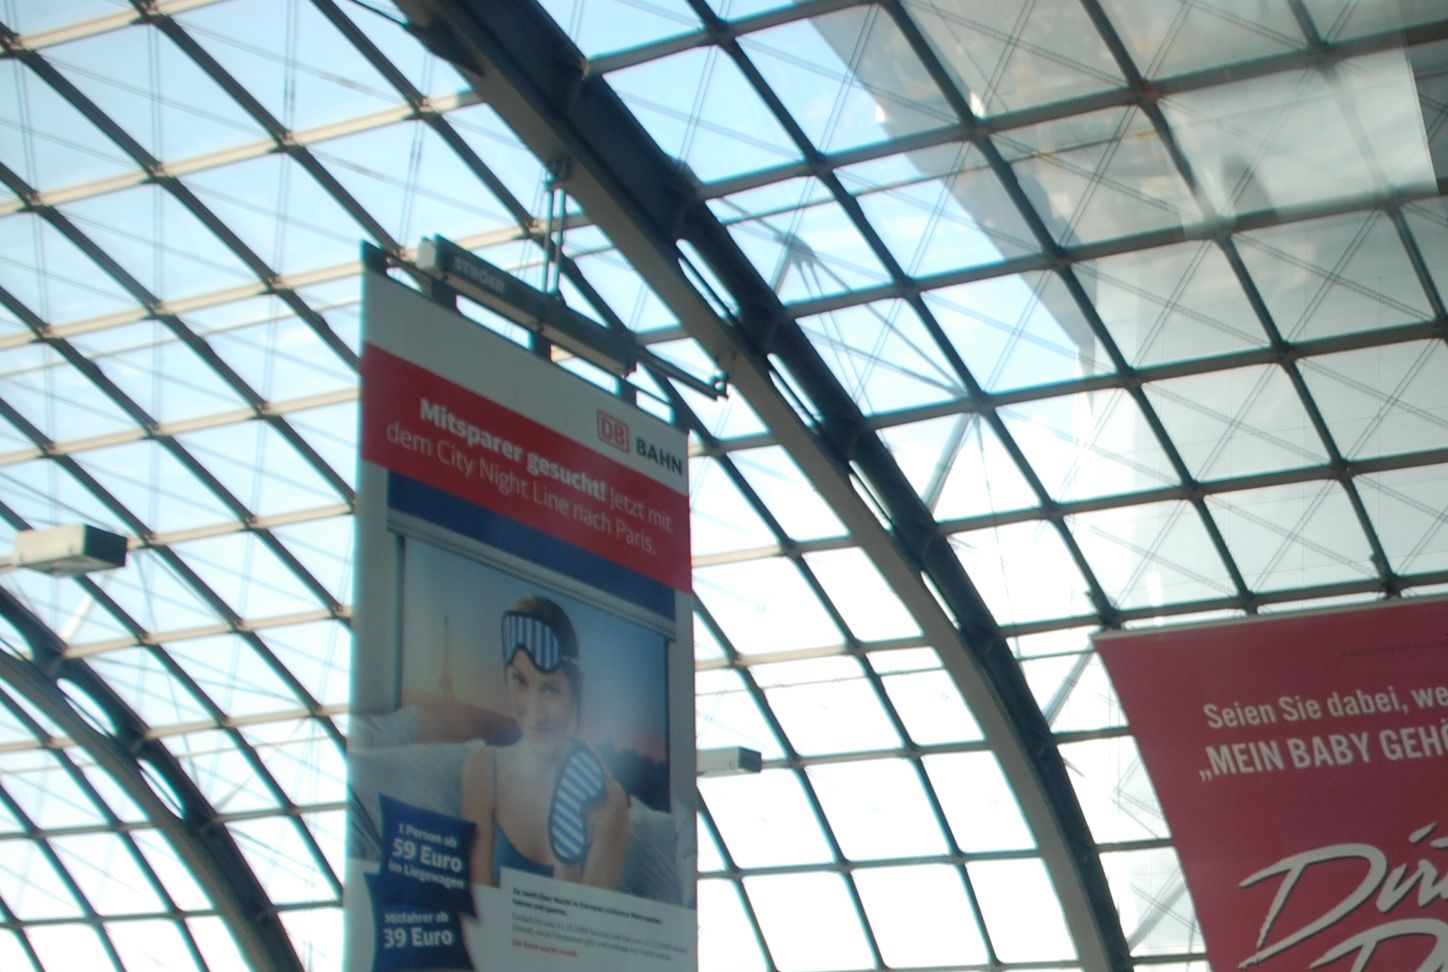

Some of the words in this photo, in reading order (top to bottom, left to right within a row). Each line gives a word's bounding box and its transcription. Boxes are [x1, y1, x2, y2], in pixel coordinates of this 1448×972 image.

[598, 411, 628, 453] DB
[636, 438, 683, 476] BAHN
[420, 398, 523, 463] Mitsparer
[527, 450, 607, 501] gesucht!
[609, 487, 645, 519] Jetzt
[648, 508, 672, 534] mit
[386, 421, 432, 457] dem
[437, 440, 474, 476] City
[480, 459, 528, 497] Night
[533, 487, 569, 516] Line
[573, 505, 611, 534] nach
[616, 524, 656, 554] Paris.
[1203, 702, 1276, 730] Seien
[1277, 695, 1322, 722] Sie
[1327, 686, 1409, 718] dabei,
[1199, 741, 1285, 782] „MEIN
[1288, 732, 1371, 769] BABY
[392, 838, 416, 860] 59
[421, 845, 463, 871] Euro
[405, 824, 442, 845] Person
[444, 834, 458, 847] ab
[404, 864, 464, 891] Liegewagen
[385, 910, 433, 925] Mitfahrer
[435, 911, 448, 923] ab
[383, 928, 406, 948] 39
[412, 927, 454, 947] Euro
